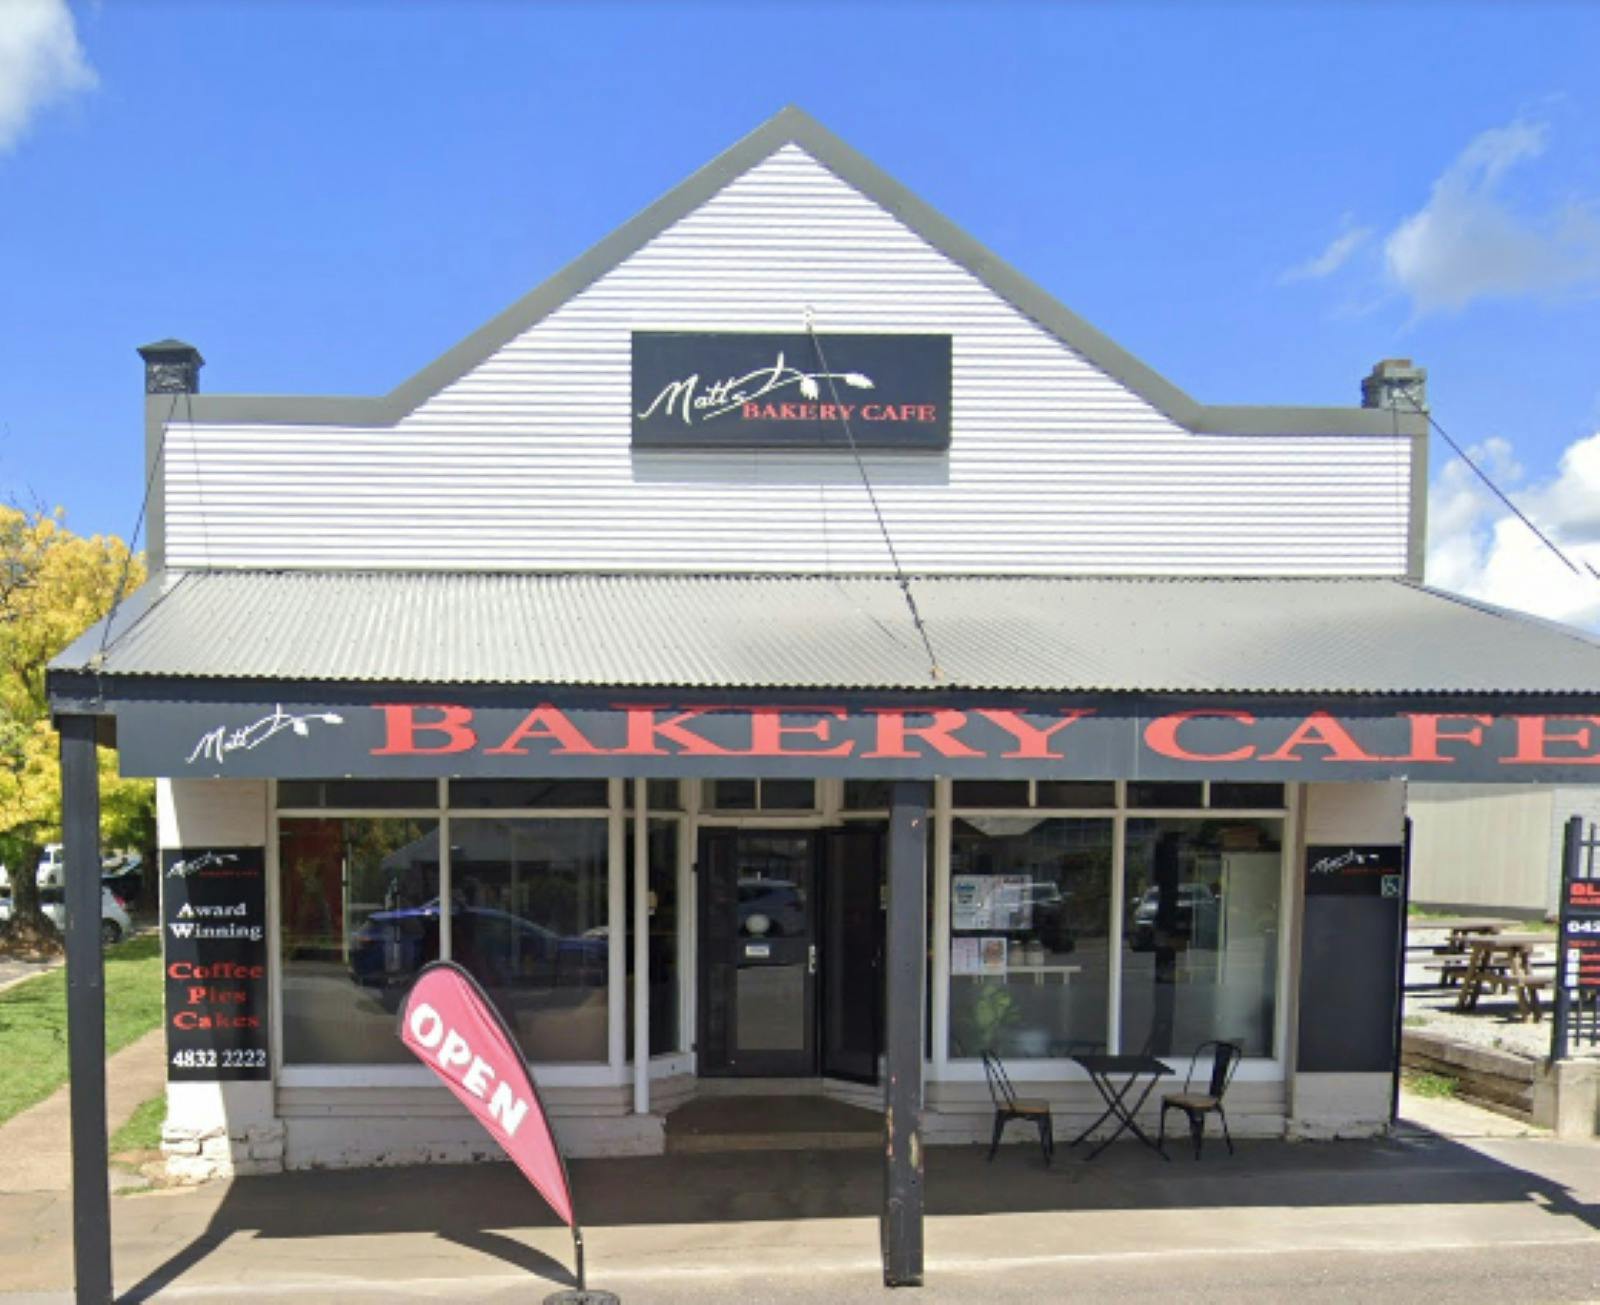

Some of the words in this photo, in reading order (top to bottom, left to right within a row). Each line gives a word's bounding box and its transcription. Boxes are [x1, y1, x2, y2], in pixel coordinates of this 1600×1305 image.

[742, 402, 855, 420] BAKERY
[861, 404, 936, 421] CAFE
[369, 702, 1096, 759] BAKERY
[1143, 709, 1600, 764] CAFE
[176, 902, 247, 919] Award
[168, 922, 263, 941] Winning
[167, 961, 264, 979] Coffee
[187, 985, 246, 1005] Pies
[173, 1011, 260, 1030] Cakes
[171, 1049, 218, 1068] 4832
[221, 1049, 266, 1068] 2222
[410, 1003, 528, 1136] OPEN
